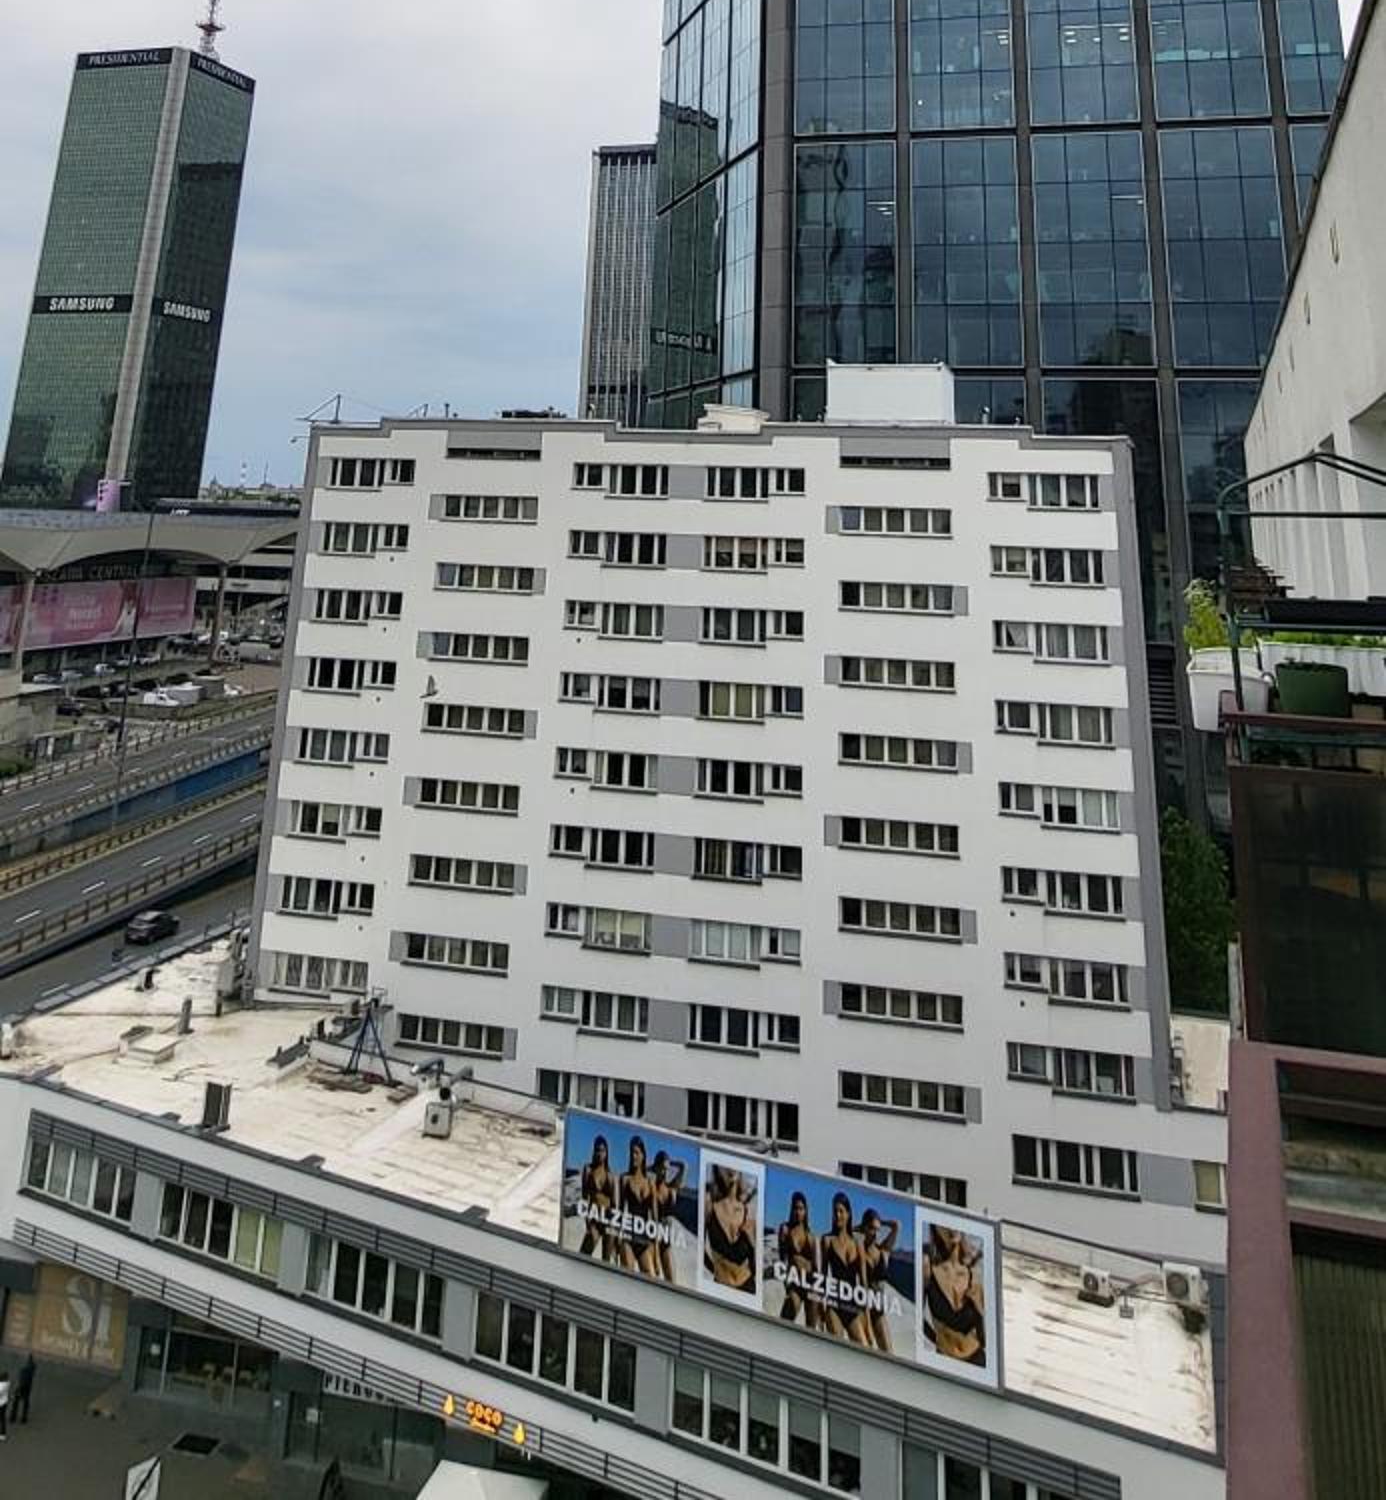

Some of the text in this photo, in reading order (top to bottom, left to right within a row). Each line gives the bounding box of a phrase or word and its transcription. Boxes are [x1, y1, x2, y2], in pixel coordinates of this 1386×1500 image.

[88, 52, 160, 66] PRESIDENTIAL
[49, 297, 114, 311] SAMSUNG
[163, 301, 211, 323] SAMSUNG
[577, 1198, 688, 1250] CALZEDONIA
[773, 1260, 903, 1317] CALZEDONIA
[465, 1401, 503, 1427] COCO
